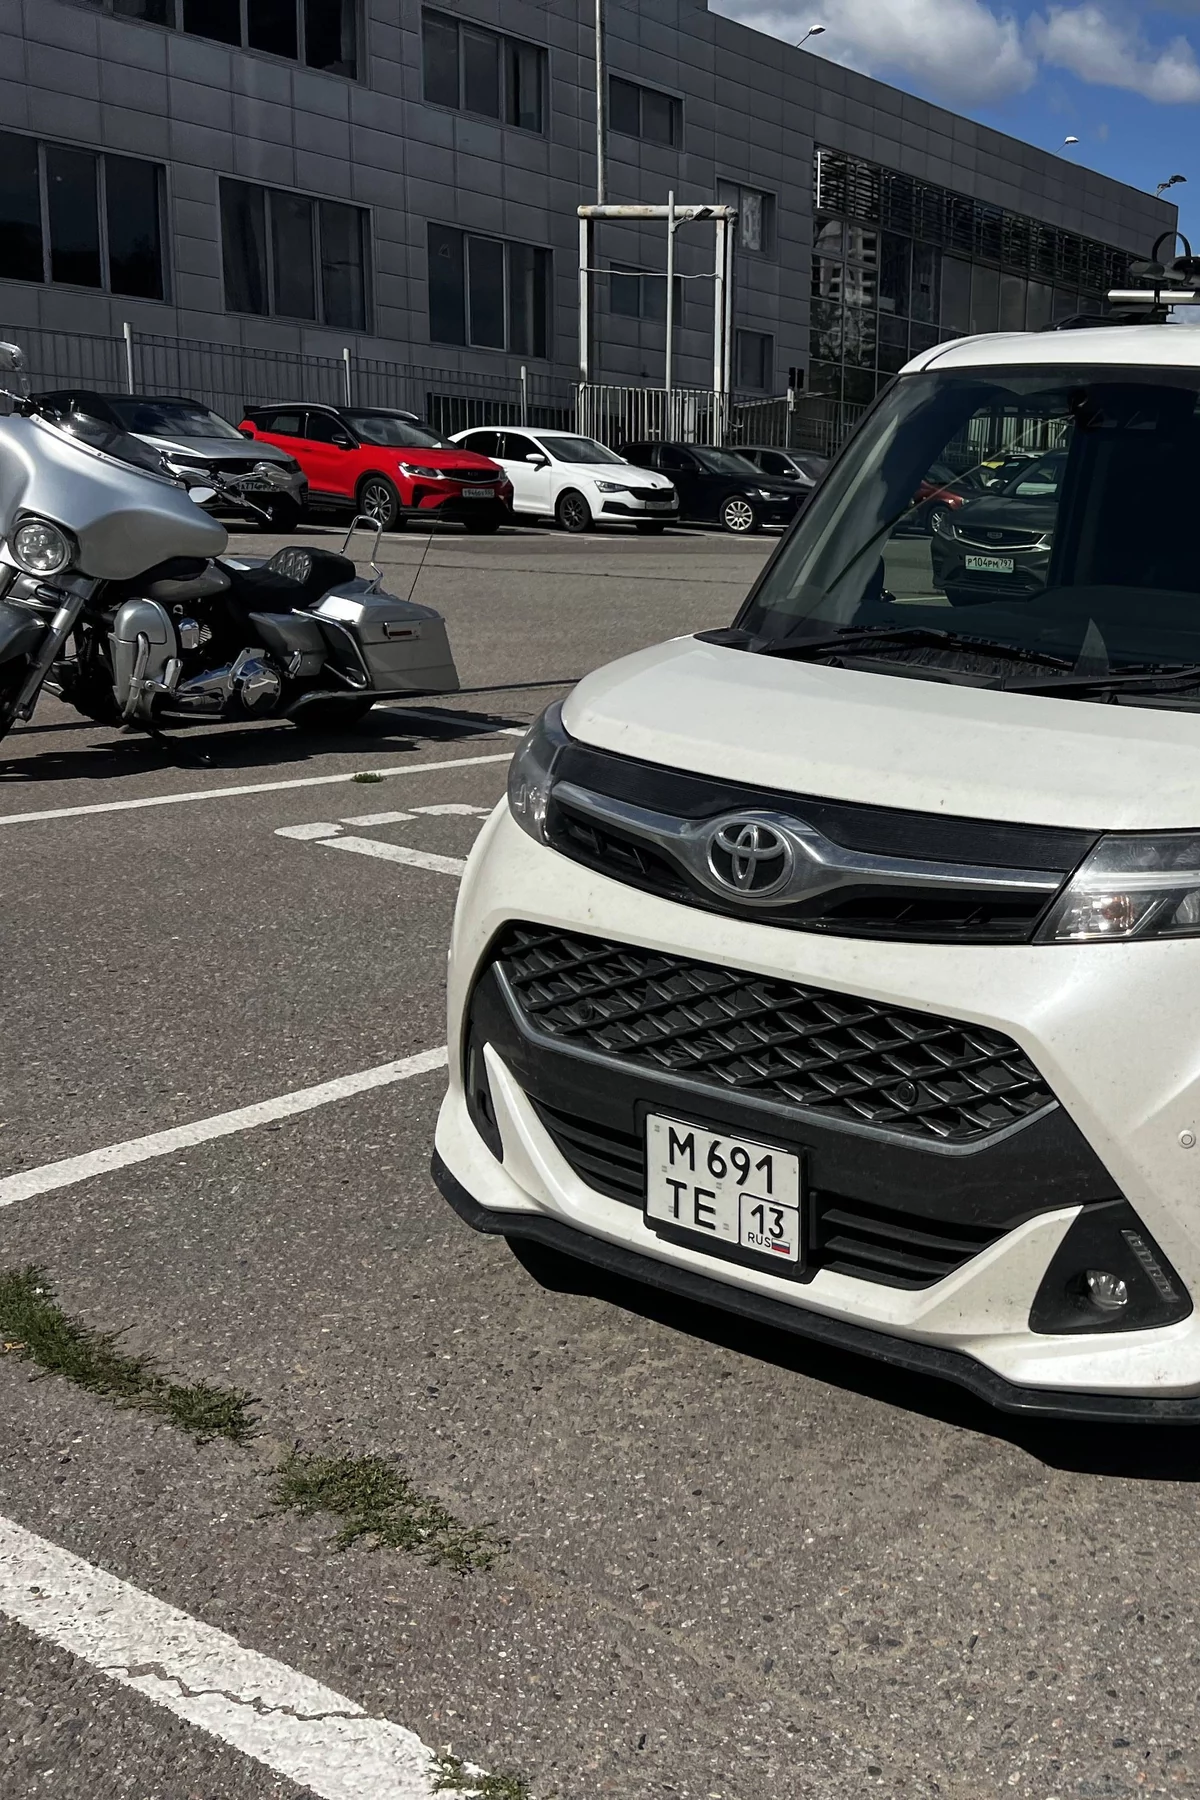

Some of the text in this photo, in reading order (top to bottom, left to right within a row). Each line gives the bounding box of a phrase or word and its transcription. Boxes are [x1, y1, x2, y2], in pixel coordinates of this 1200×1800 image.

[666, 1177, 716, 1230] ТЕ
[751, 1204, 784, 1238] 13
[748, 1232, 771, 1248] RUS
